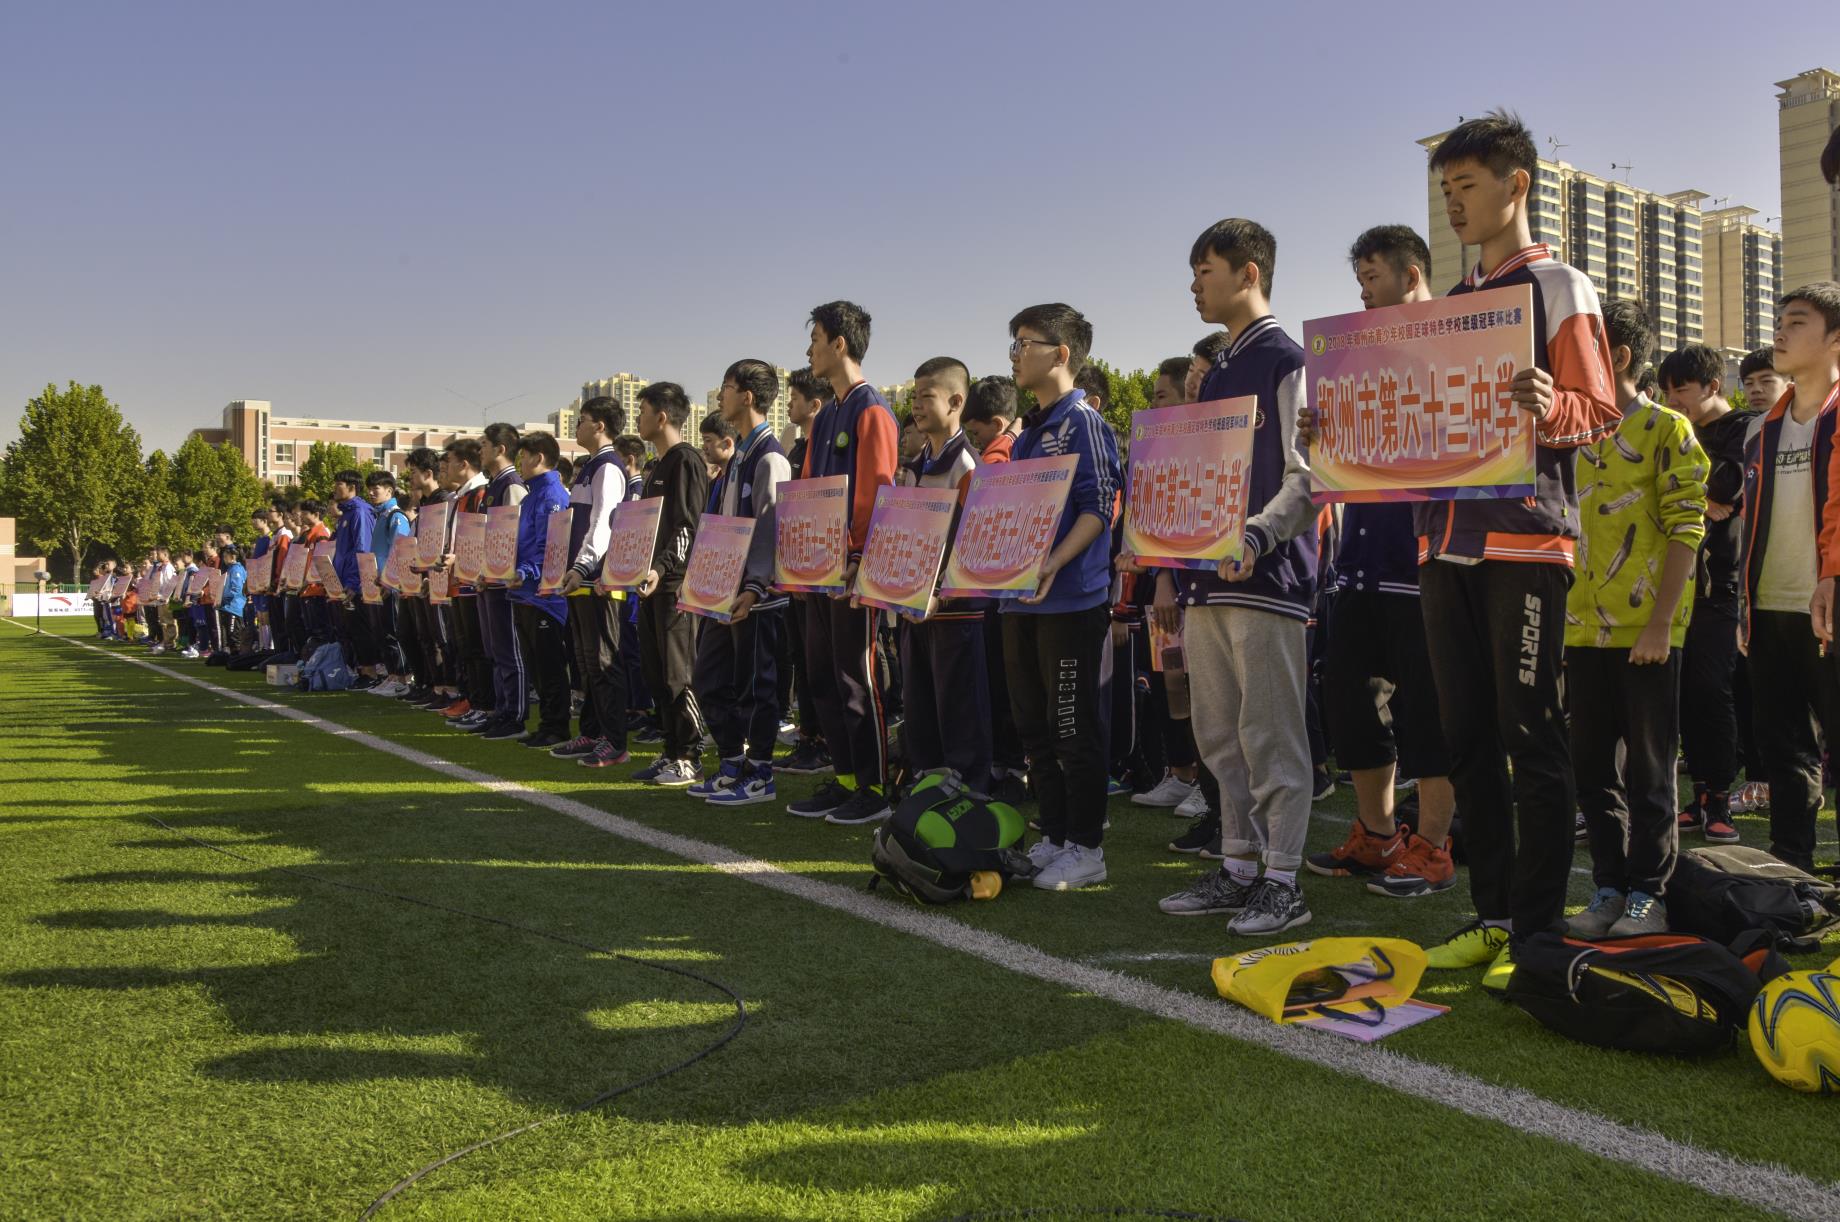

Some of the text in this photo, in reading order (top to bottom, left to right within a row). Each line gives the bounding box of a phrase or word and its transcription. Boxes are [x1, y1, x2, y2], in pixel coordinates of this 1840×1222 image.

[1316, 355, 1519, 463] 郑州市第六十三中学
[1129, 455, 1242, 535] 郑州市第六十二中学
[1518, 593, 1542, 687] SPORTS
